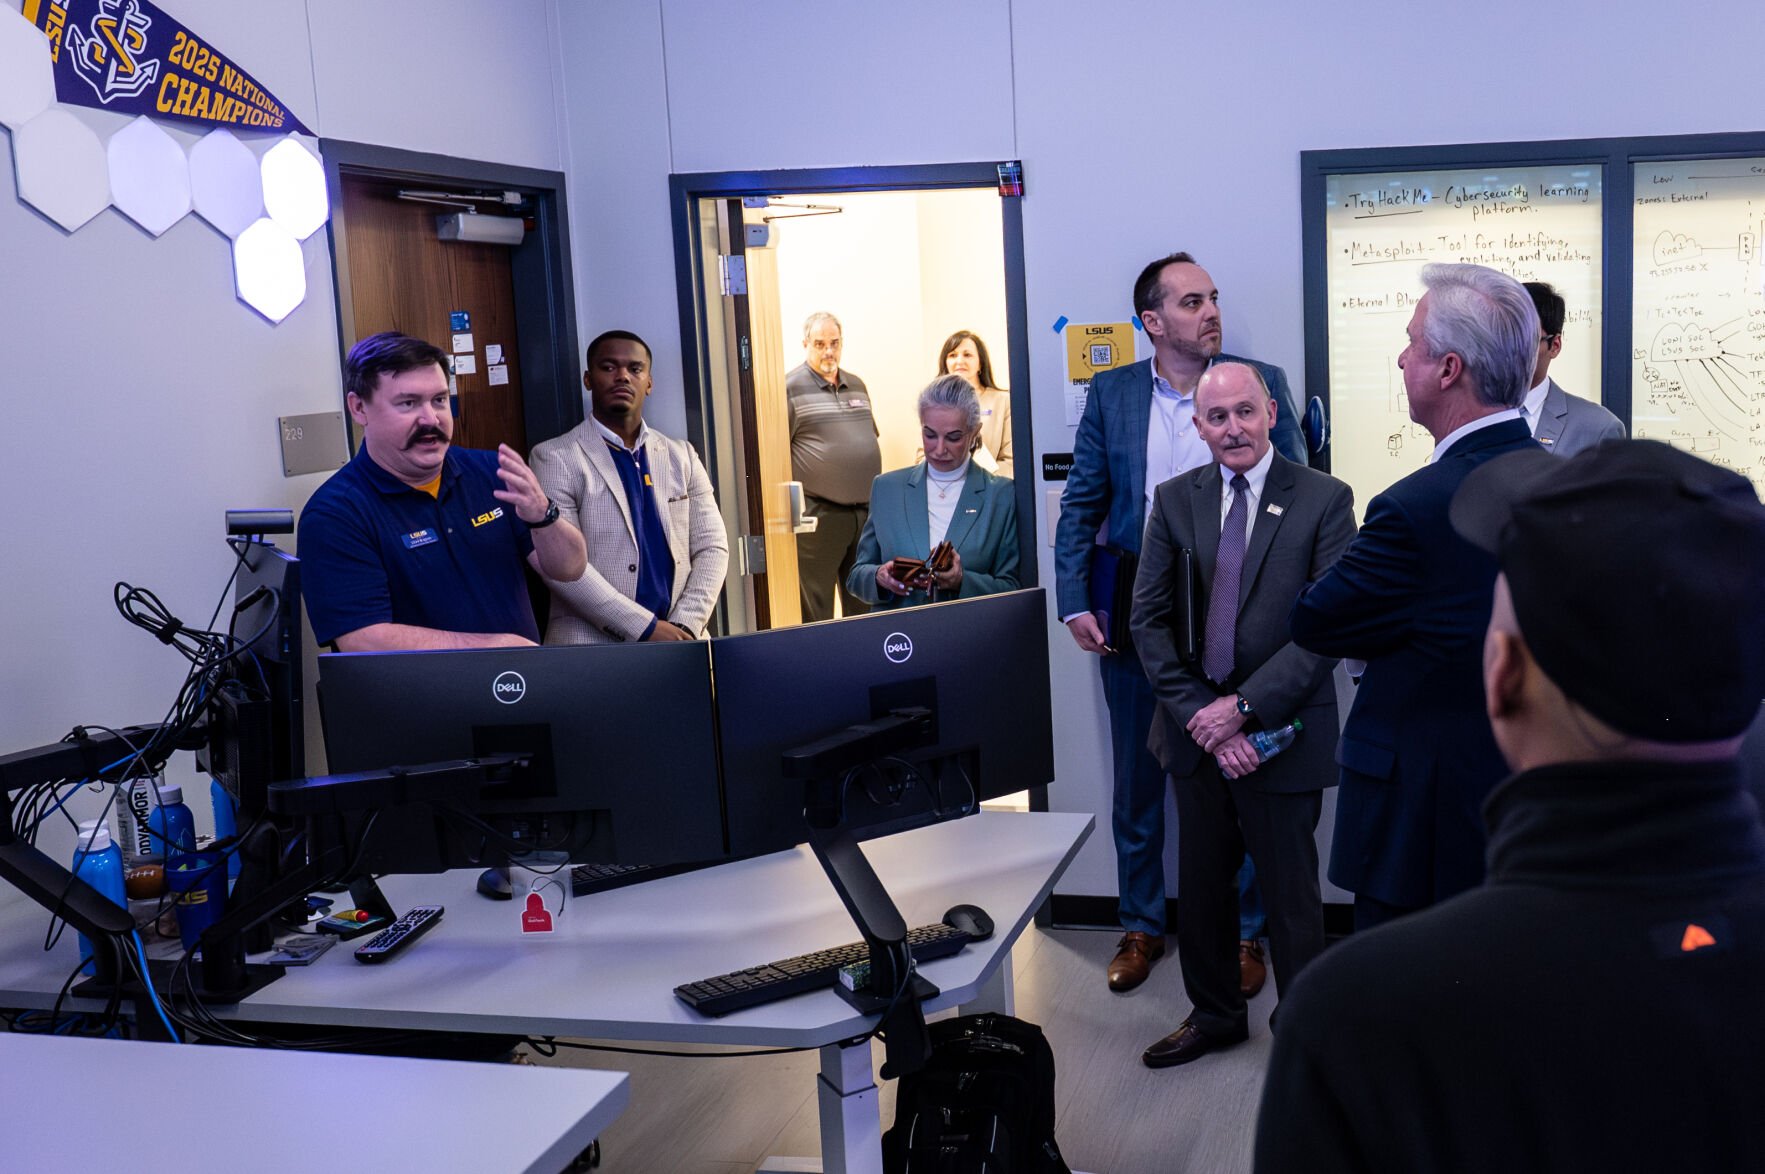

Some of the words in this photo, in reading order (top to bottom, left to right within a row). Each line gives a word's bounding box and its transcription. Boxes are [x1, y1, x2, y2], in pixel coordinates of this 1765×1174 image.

[168, 31, 221, 82] 2025
[219, 64, 285, 120] NATIONAL
[156, 72, 284, 128] CHAMPIONS
[1445, 185, 1529, 208] Cybersecurity
[1540, 184, 1589, 202] learning
[1437, 234, 1466, 251] Tool
[1475, 233, 1496, 249] for
[1518, 249, 1540, 262] and
[1545, 250, 1592, 266] validating
[1349, 293, 1389, 308] Eternal
[1086, 327, 1114, 335] LSUS
[1054, 463, 1070, 471] Food
[471, 507, 504, 528] LSUS
[887, 642, 910, 653] DELL
[497, 683, 522, 692] DELL
